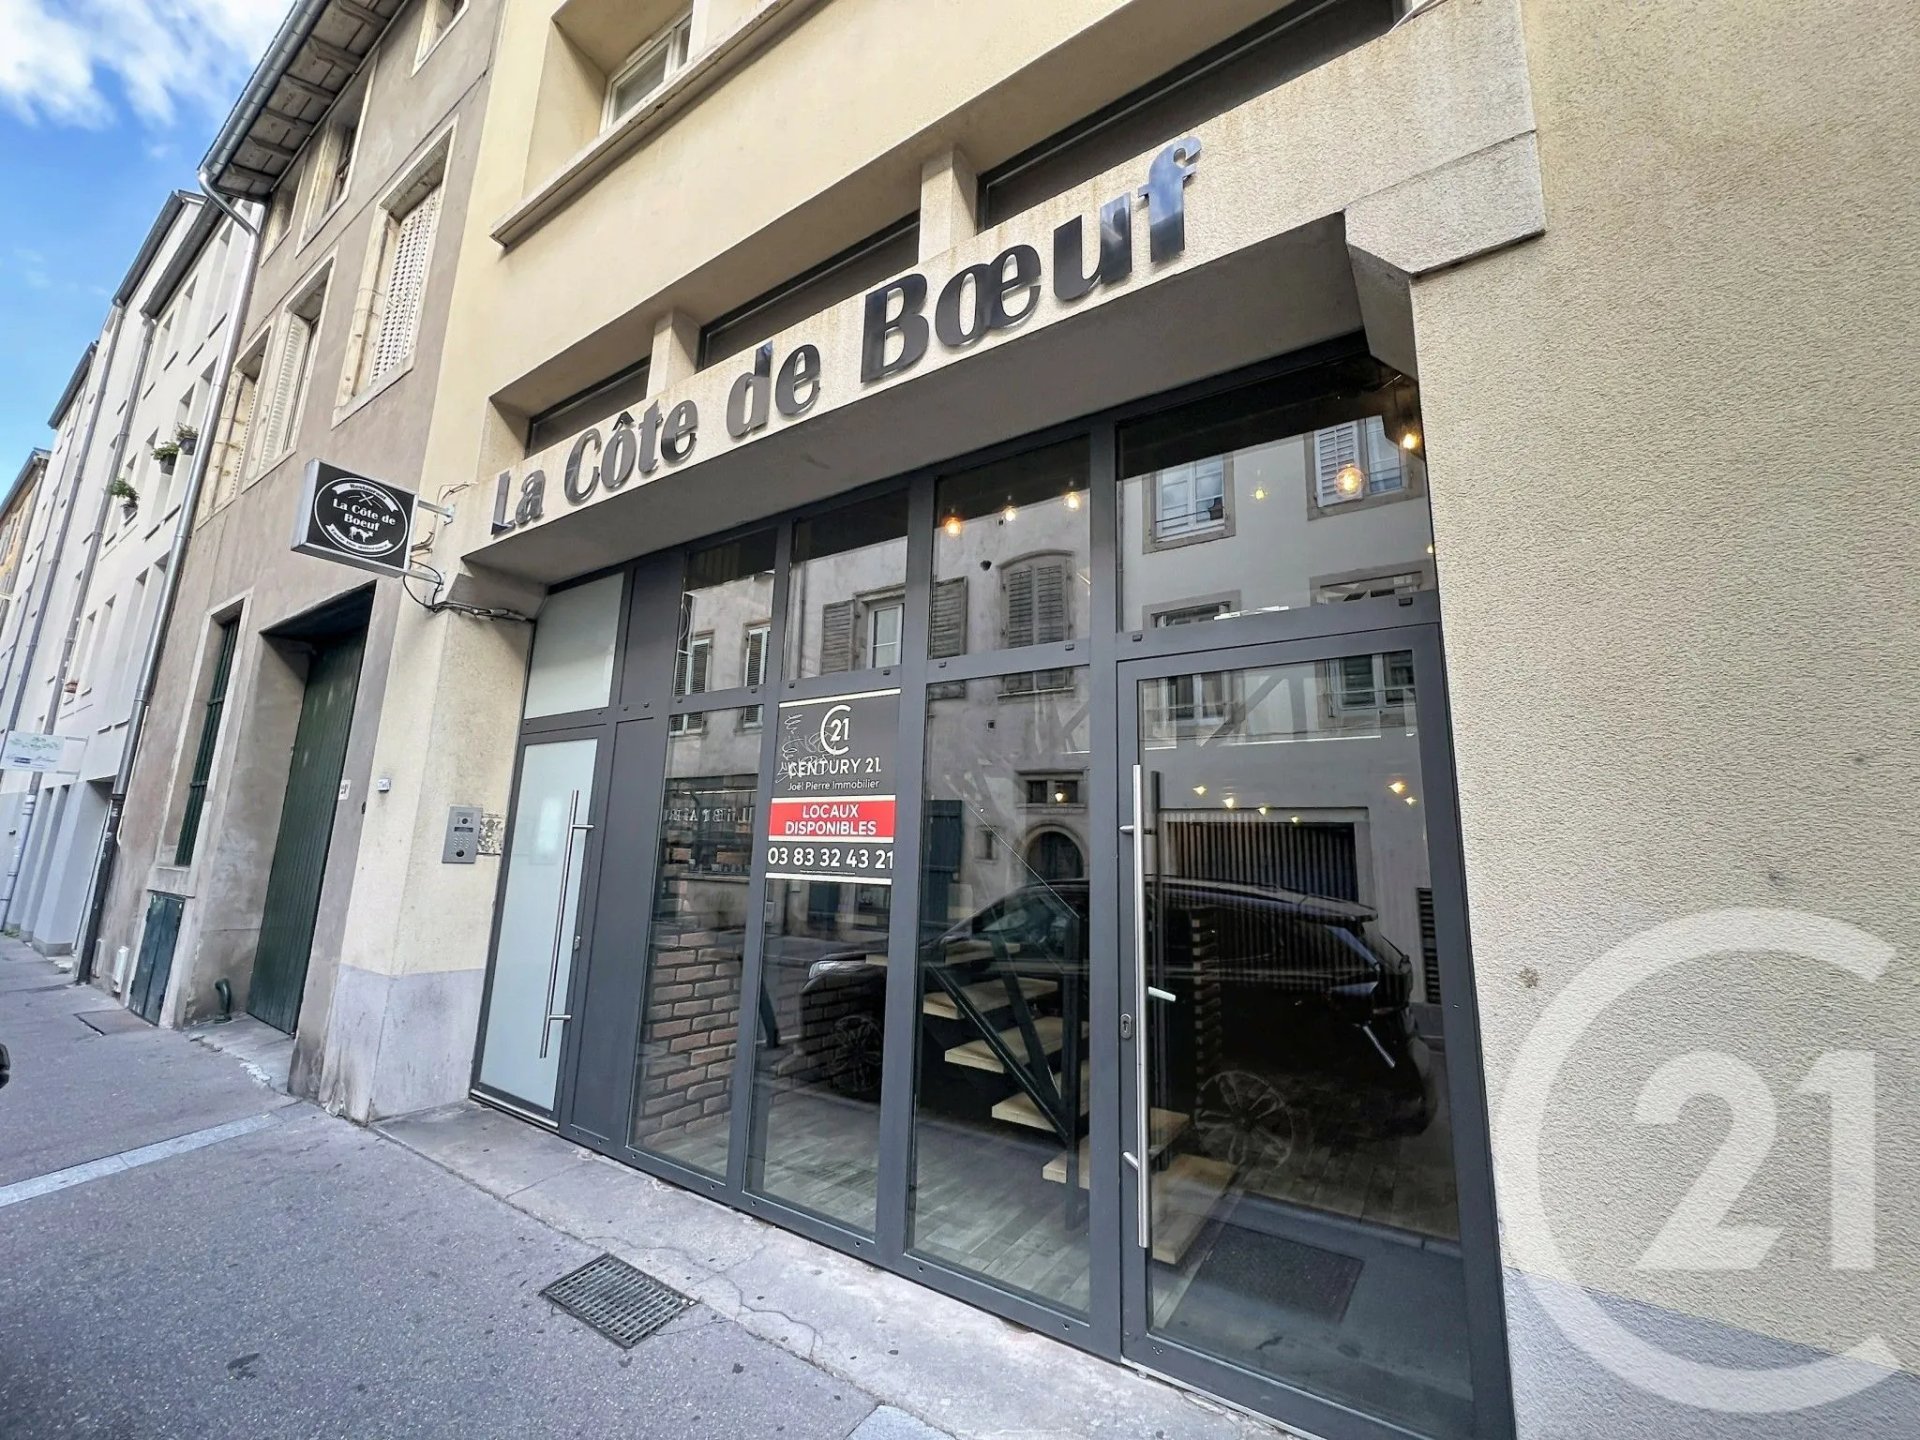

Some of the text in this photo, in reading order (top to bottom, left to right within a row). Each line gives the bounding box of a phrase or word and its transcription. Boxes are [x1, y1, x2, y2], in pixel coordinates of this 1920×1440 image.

[490, 469, 546, 536] La
[563, 399, 699, 506] Côte
[726, 340, 822, 439] de
[332, 498, 396, 526] La Côte de
[343, 513, 380, 531] Boeuf
[788, 758, 862, 776] CENTURY
[805, 780, 830, 791] Pierre
[832, 779, 880, 790] Immobilier
[802, 804, 859, 819] LOCAUX
[785, 820, 877, 836] DISPONIBLES
[767, 847, 894, 870] 03 83 32 43 21
